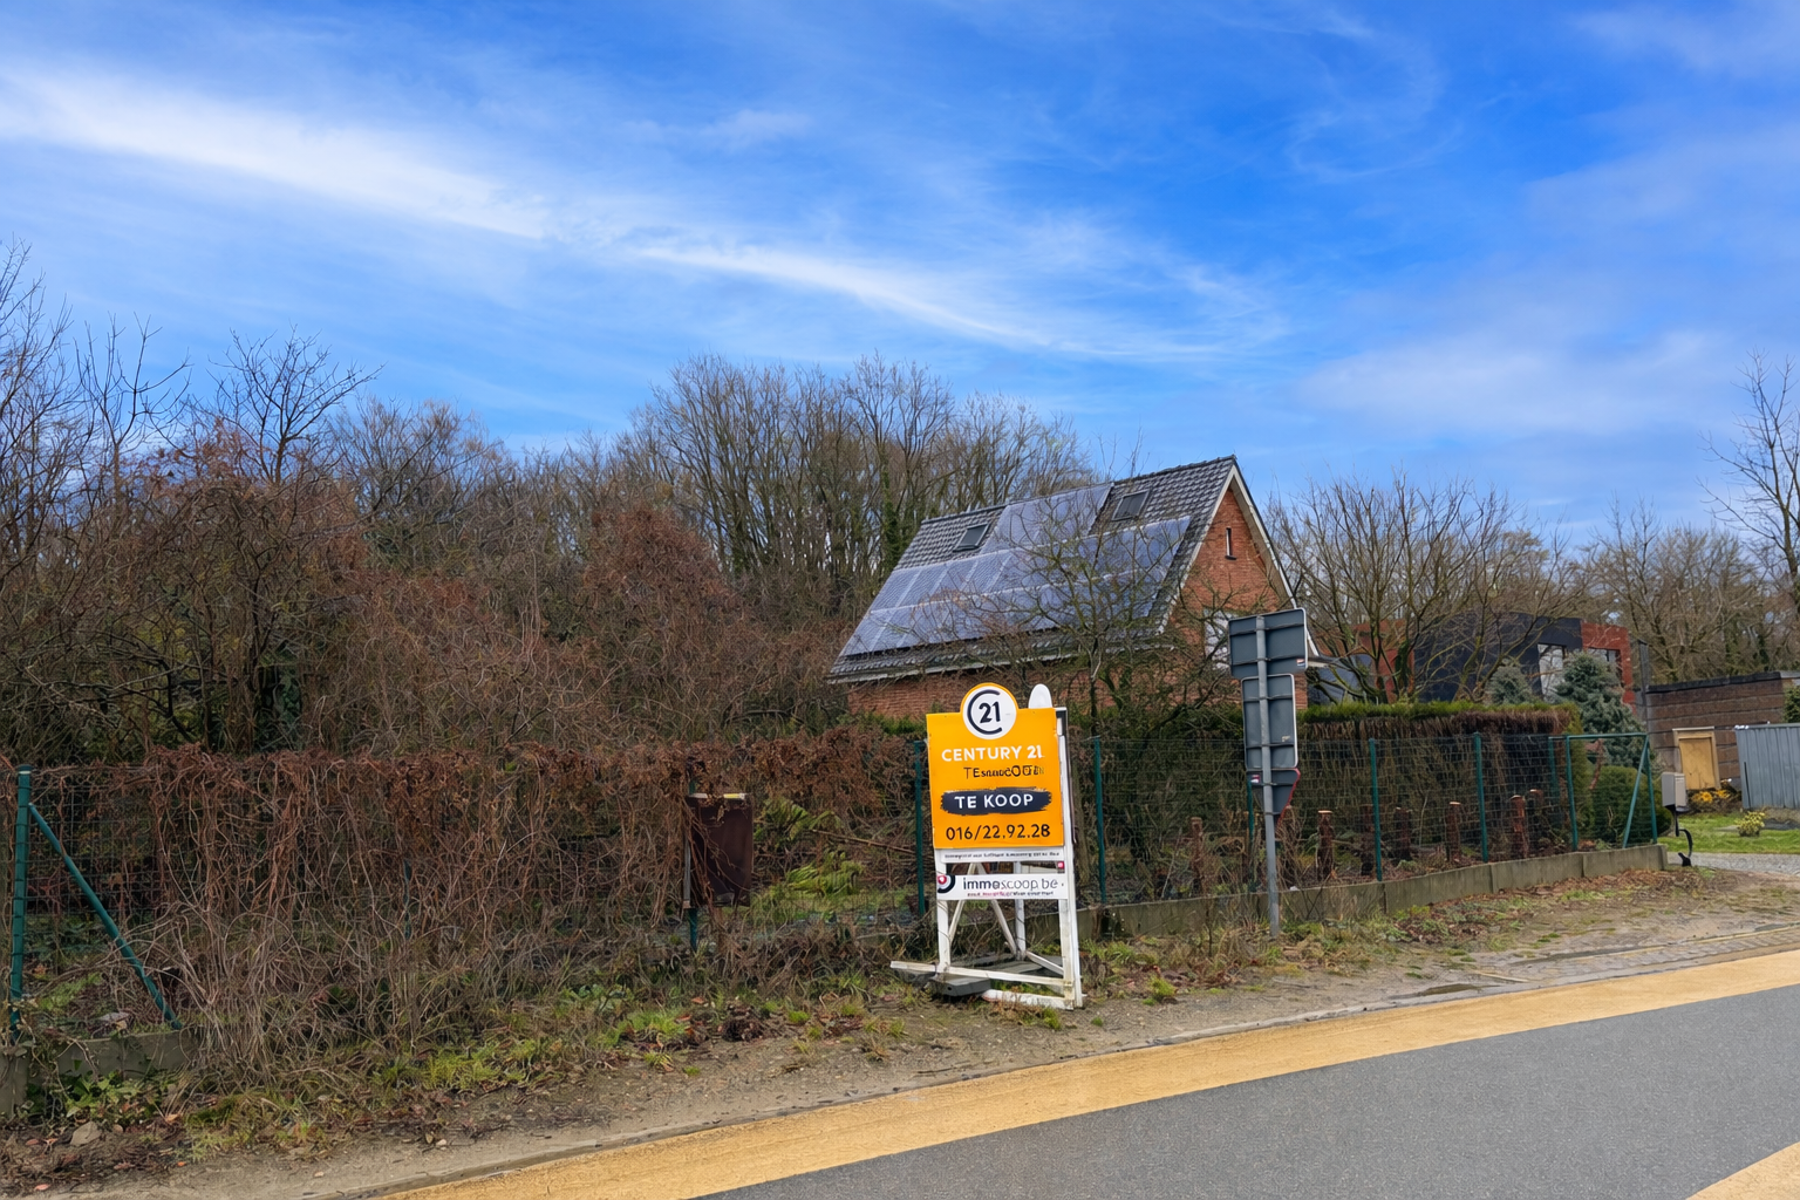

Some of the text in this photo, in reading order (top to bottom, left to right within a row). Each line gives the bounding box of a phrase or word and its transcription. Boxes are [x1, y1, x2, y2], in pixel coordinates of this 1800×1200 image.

[941, 744, 1044, 762] CENTURY 21
[954, 794, 1034, 809] TE KOOP
[946, 823, 1051, 841] 016/22.92.28
